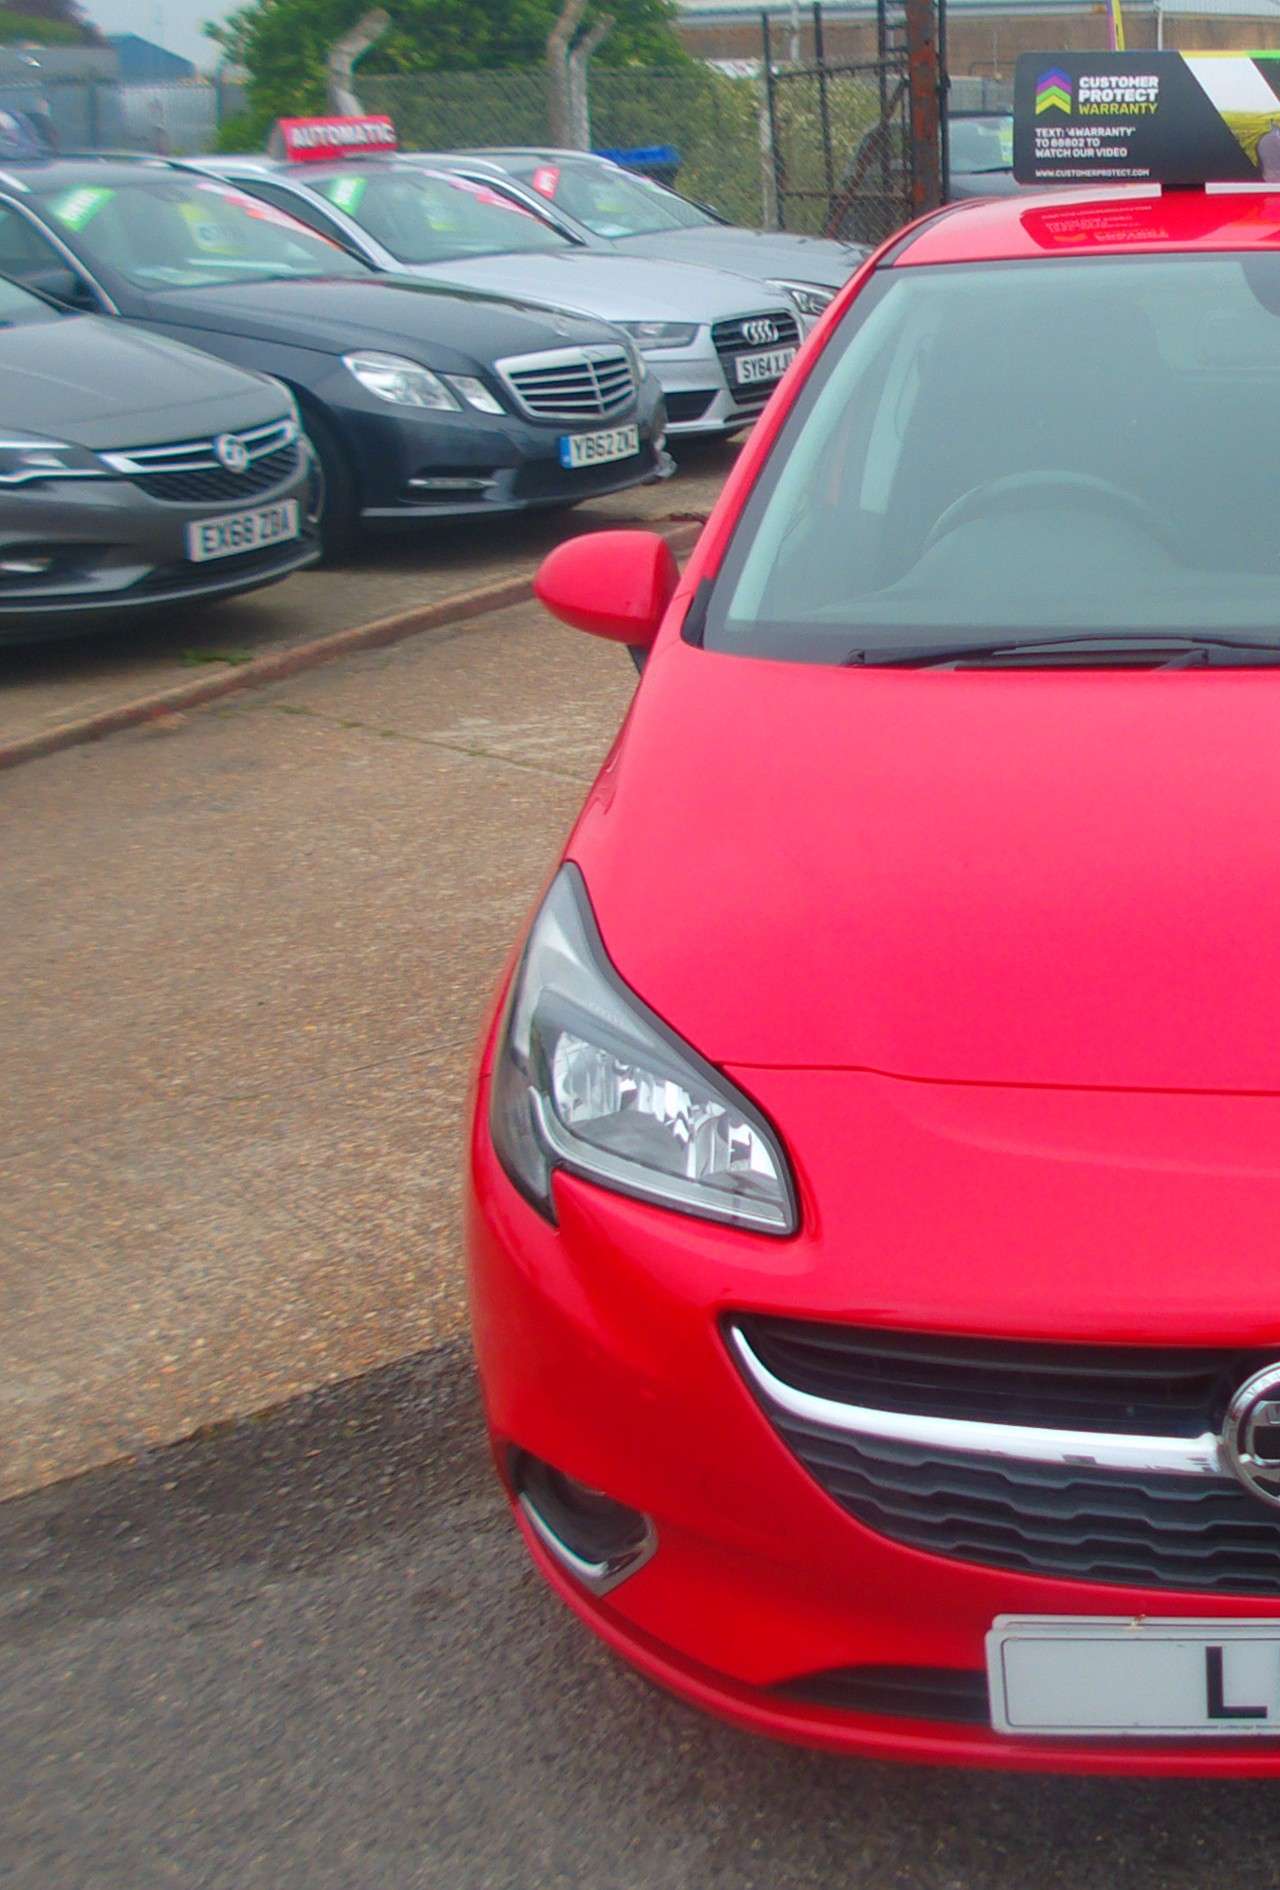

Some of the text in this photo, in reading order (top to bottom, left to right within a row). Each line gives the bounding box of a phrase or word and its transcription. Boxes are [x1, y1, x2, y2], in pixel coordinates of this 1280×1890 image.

[1079, 76, 1159, 88] CUSTOMER
[1078, 89, 1159, 103] PROTECT
[1078, 103, 1159, 115] WARRANTY
[291, 122, 397, 148] AUTOMATIC
[1035, 138, 1050, 148] TO
[1086, 137, 1101, 147] TO
[1035, 147, 1128, 158] WATCH OUR VIDEO
